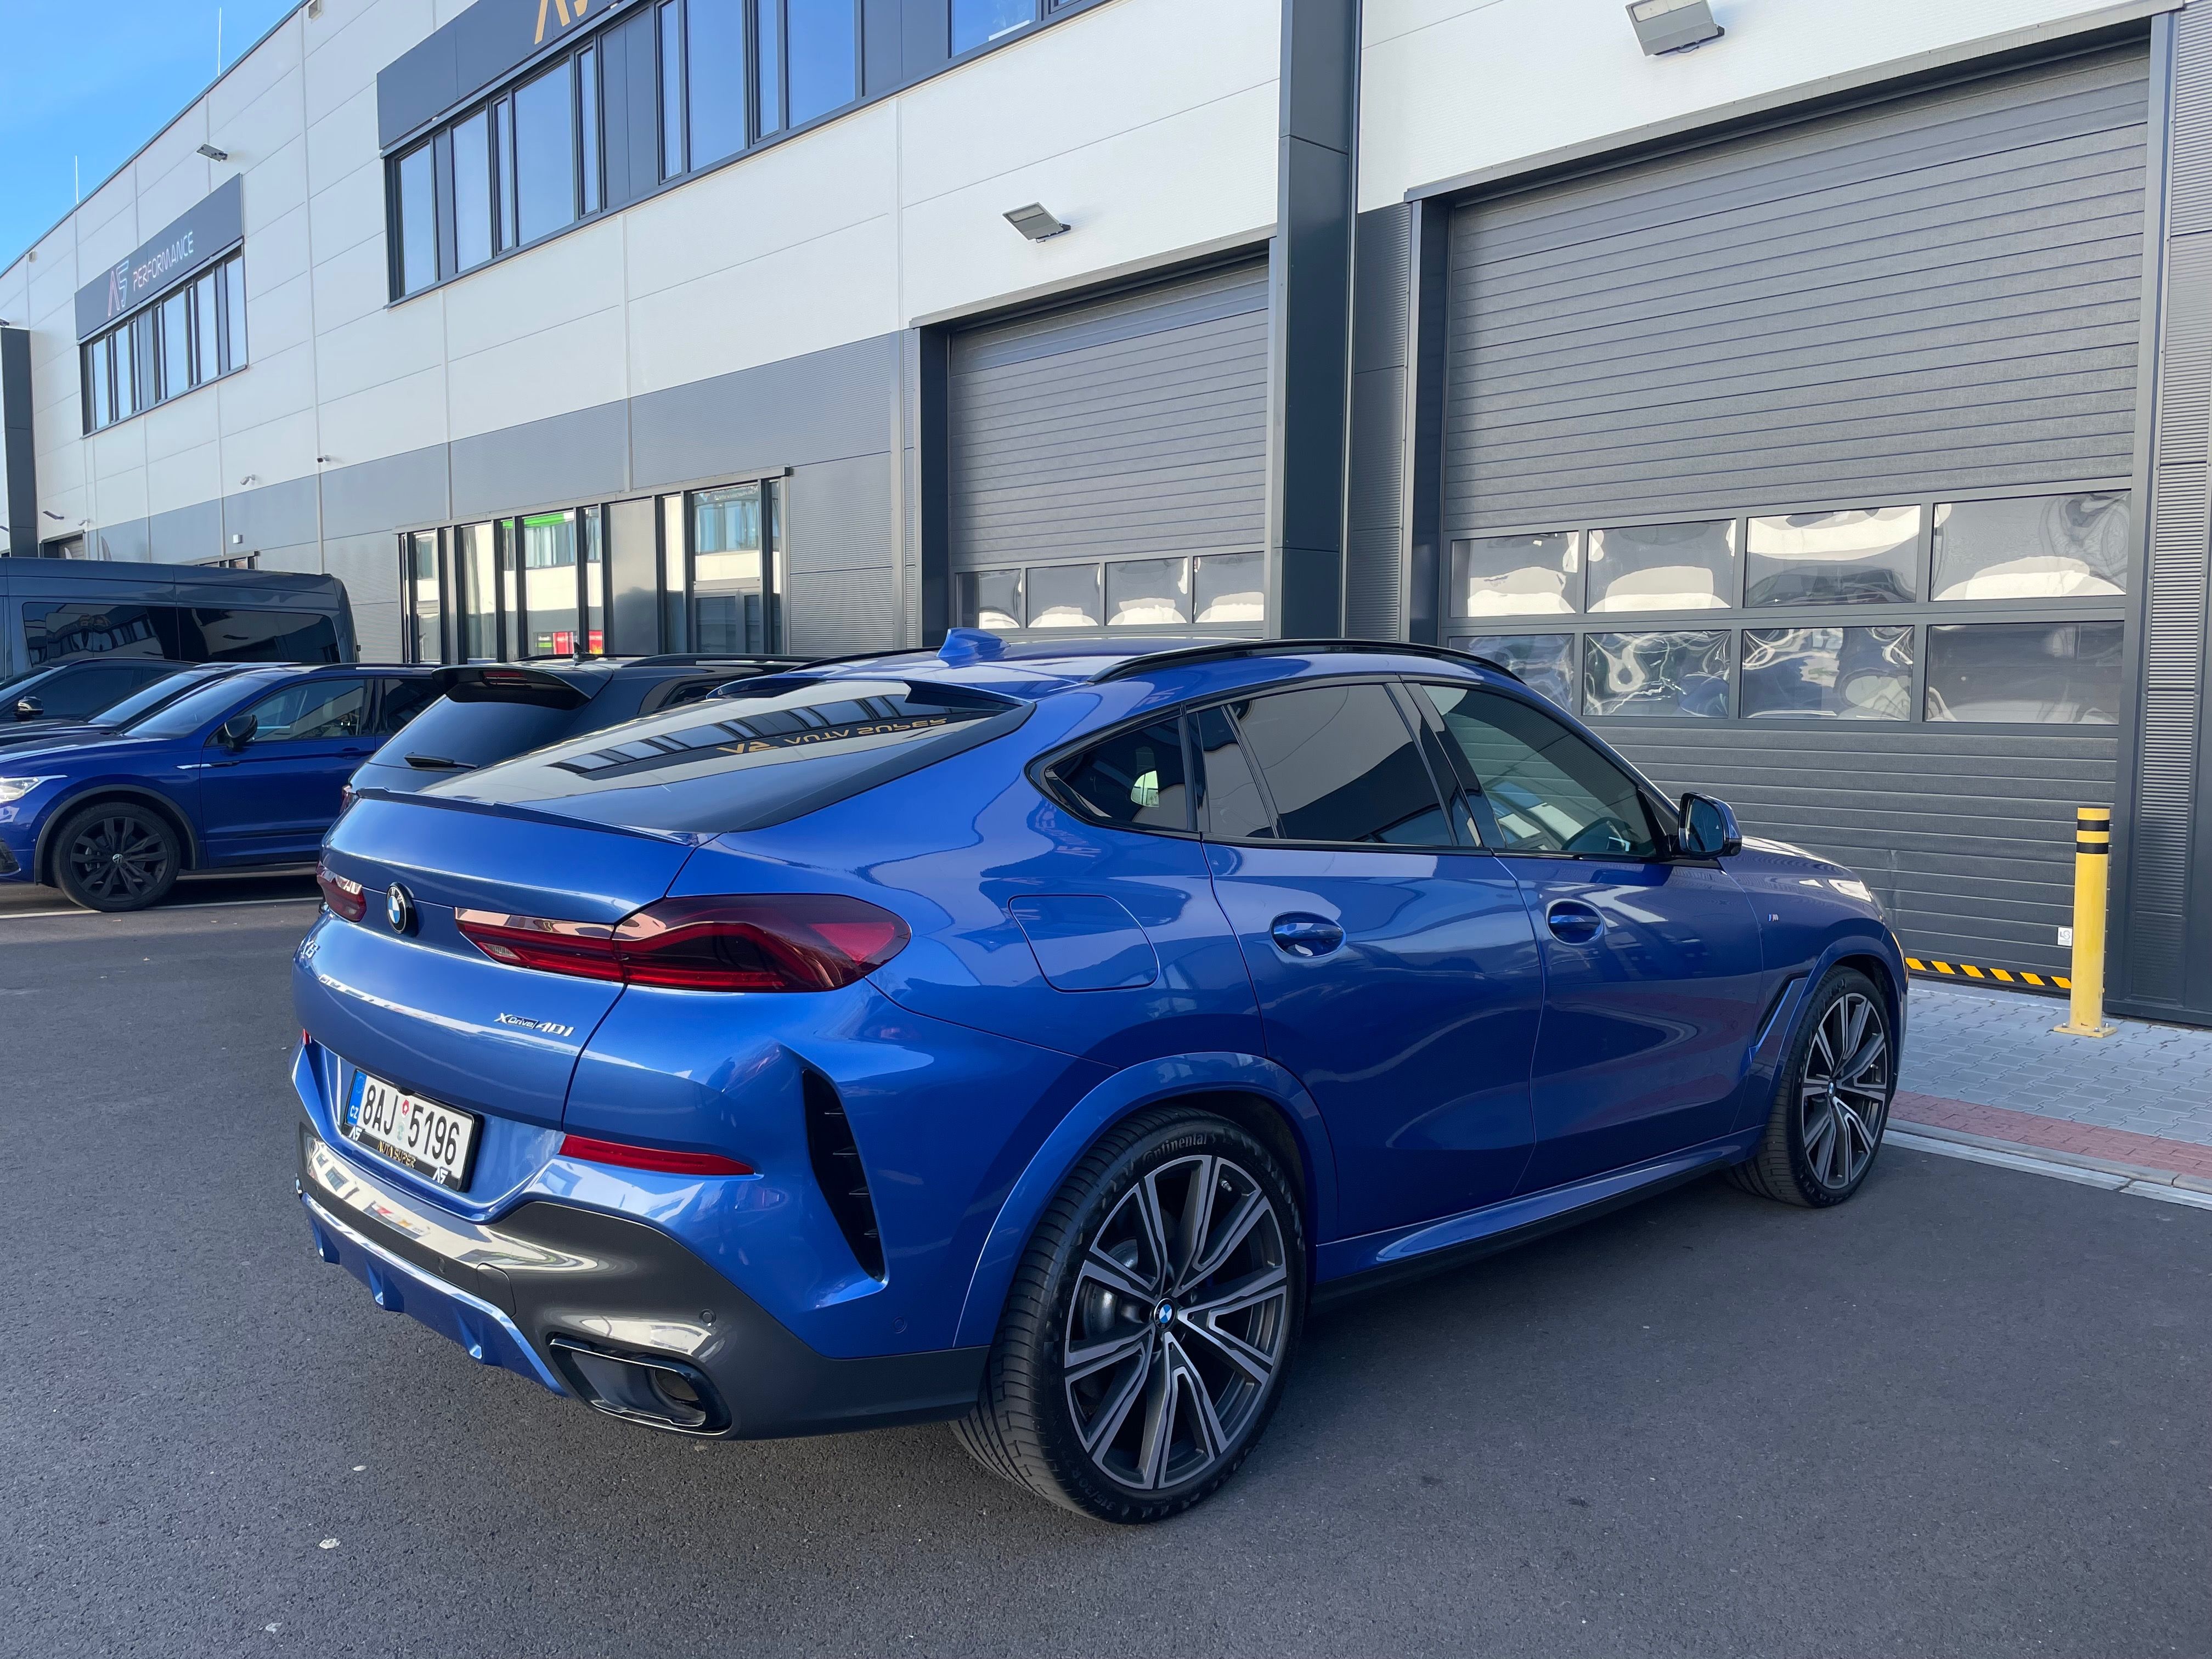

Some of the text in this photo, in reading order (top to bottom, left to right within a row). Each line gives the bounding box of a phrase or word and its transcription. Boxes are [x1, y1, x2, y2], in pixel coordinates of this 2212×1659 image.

[133, 231, 194, 292] PERFORMANCE
[349, 1105, 359, 1119] CZ
[363, 1085, 460, 1165] 8AJ 5196
[394, 1147, 416, 1168] SUPER
[1142, 1132, 1207, 1163] Continental
